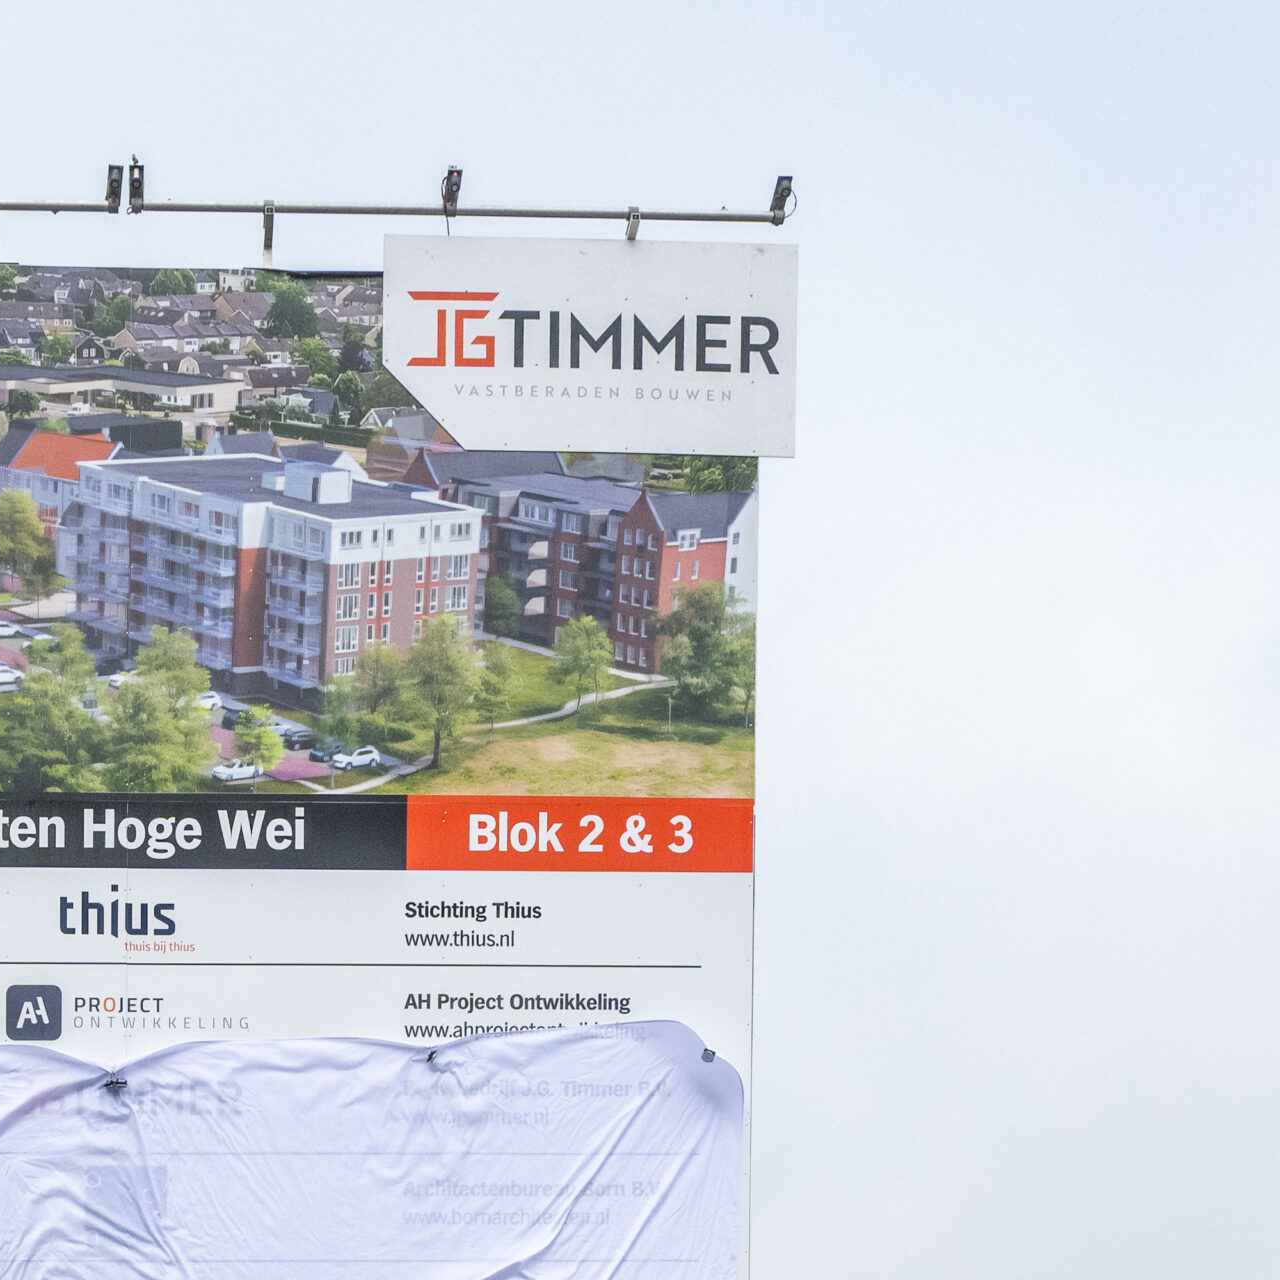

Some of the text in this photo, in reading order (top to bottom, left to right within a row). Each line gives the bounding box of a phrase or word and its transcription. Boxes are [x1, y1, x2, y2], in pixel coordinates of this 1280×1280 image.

[454, 383, 732, 402] VASTBERADEN BOUWEN
[83, 807, 203, 860] Hoge
[217, 805, 305, 851] Wei
[468, 810, 694, 853] Blok 2 & 3
[59, 884, 176, 938] thius
[404, 900, 542, 923] Stichting Thius
[124, 941, 196, 954] thuis bij thius
[404, 929, 516, 947] www.thius.nl
[73, 997, 164, 1013] PROJECT
[404, 992, 631, 1015] AH Project Ontwikkeling
[73, 1015, 250, 1030] ONTWIKKELING
